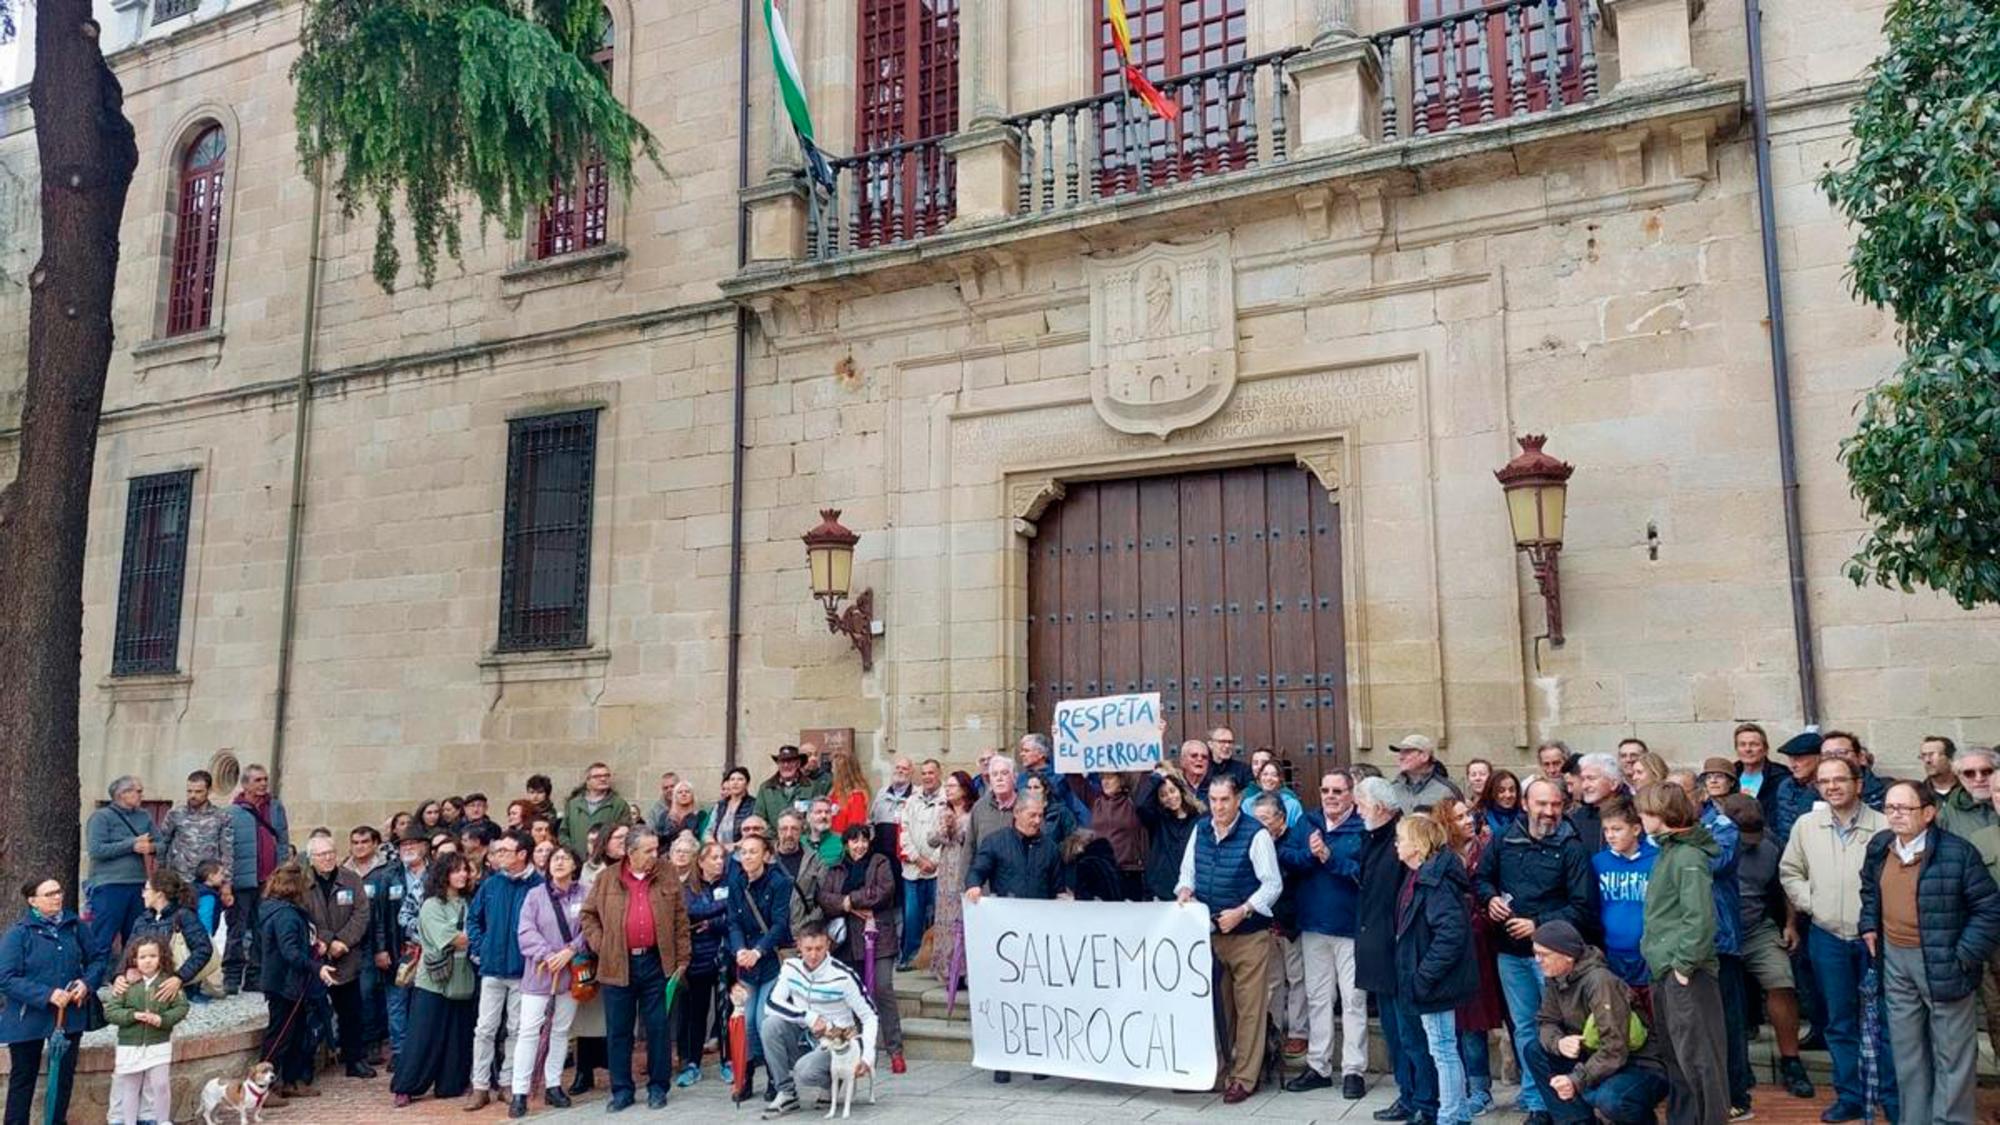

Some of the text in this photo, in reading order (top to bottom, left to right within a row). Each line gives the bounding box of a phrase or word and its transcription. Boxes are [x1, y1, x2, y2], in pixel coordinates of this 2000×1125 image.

[1058, 697, 1154, 744] RESPETA
[1059, 743, 1078, 757] EL
[1599, 871, 1648, 891] SUPER
[995, 931, 1210, 998] SALVEMOS
[1000, 1001, 1189, 1075] BERROCAL
